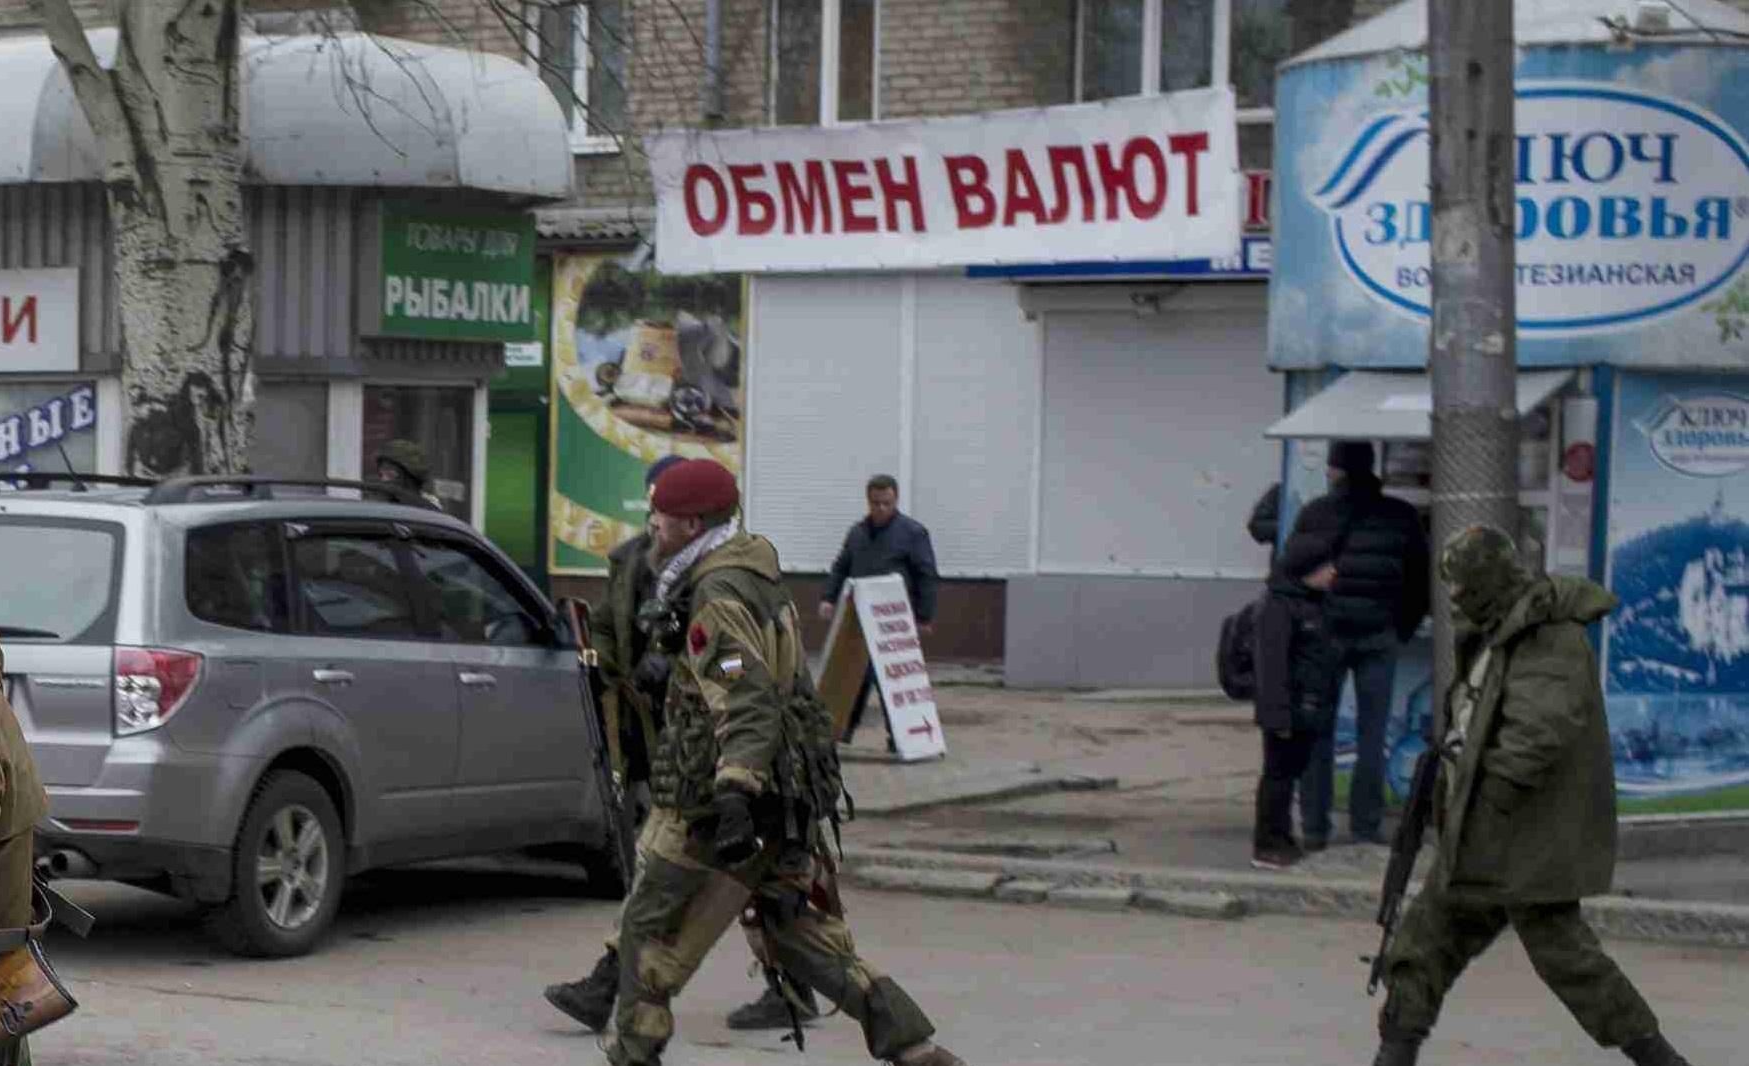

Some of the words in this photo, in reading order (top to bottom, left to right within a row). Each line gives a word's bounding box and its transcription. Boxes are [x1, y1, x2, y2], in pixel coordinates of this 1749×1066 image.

[1514, 131, 1680, 185] ЮЧ
[682, 155, 926, 238] ОБМЕН
[942, 131, 1210, 230] ВАЛЮТ
[384, 274, 532, 325] РЫБАЛКИ
[1515, 262, 1697, 288] ТЕЗИАНСКАЯ
